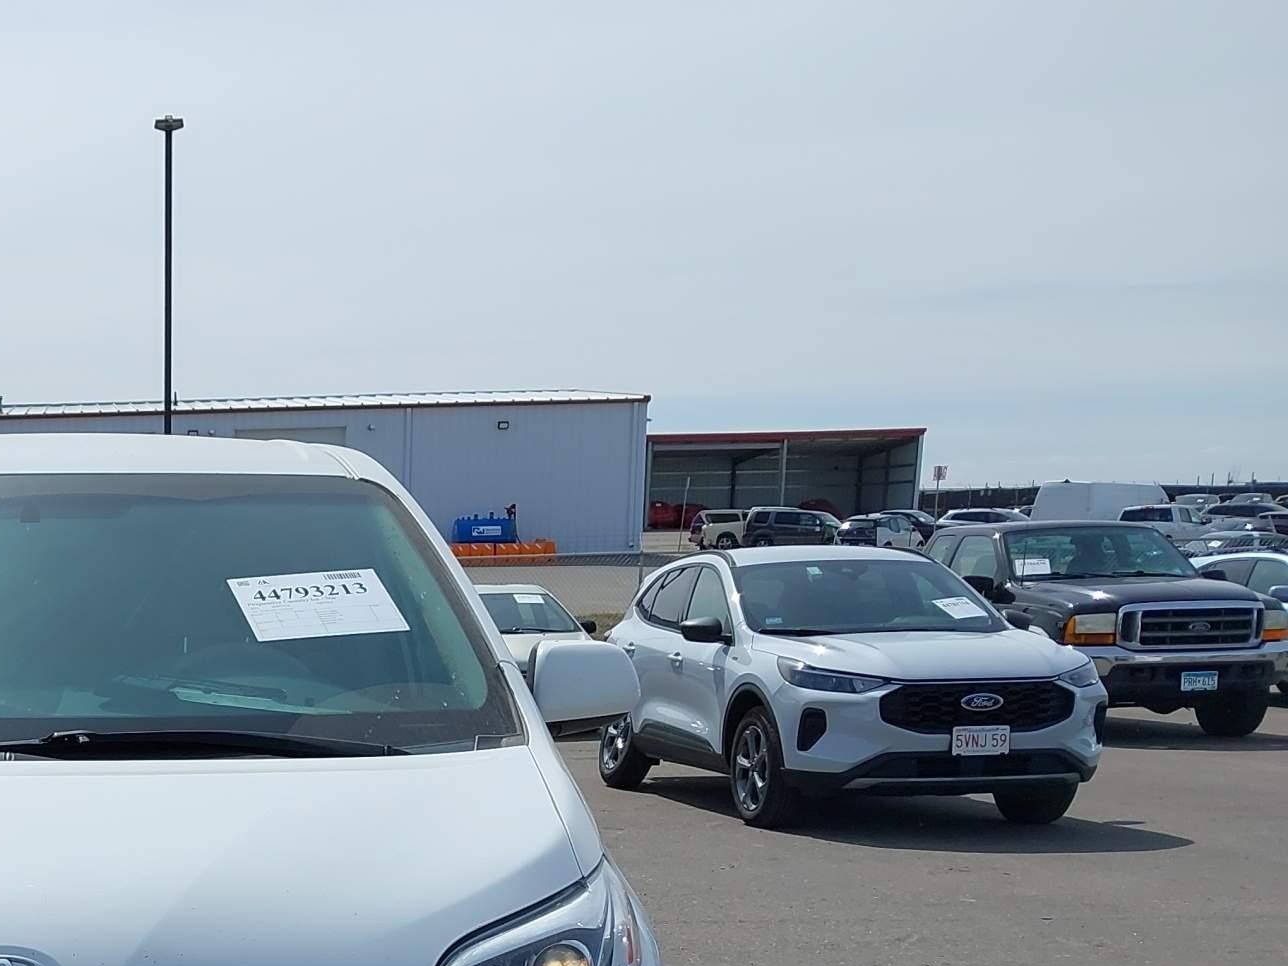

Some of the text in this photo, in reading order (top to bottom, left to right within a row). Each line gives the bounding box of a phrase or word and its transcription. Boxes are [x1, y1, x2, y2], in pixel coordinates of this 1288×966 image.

[253, 582, 368, 602] 44793213
[970, 695, 995, 706] Ford
[956, 733, 1007, 748] 5VNJ 59
